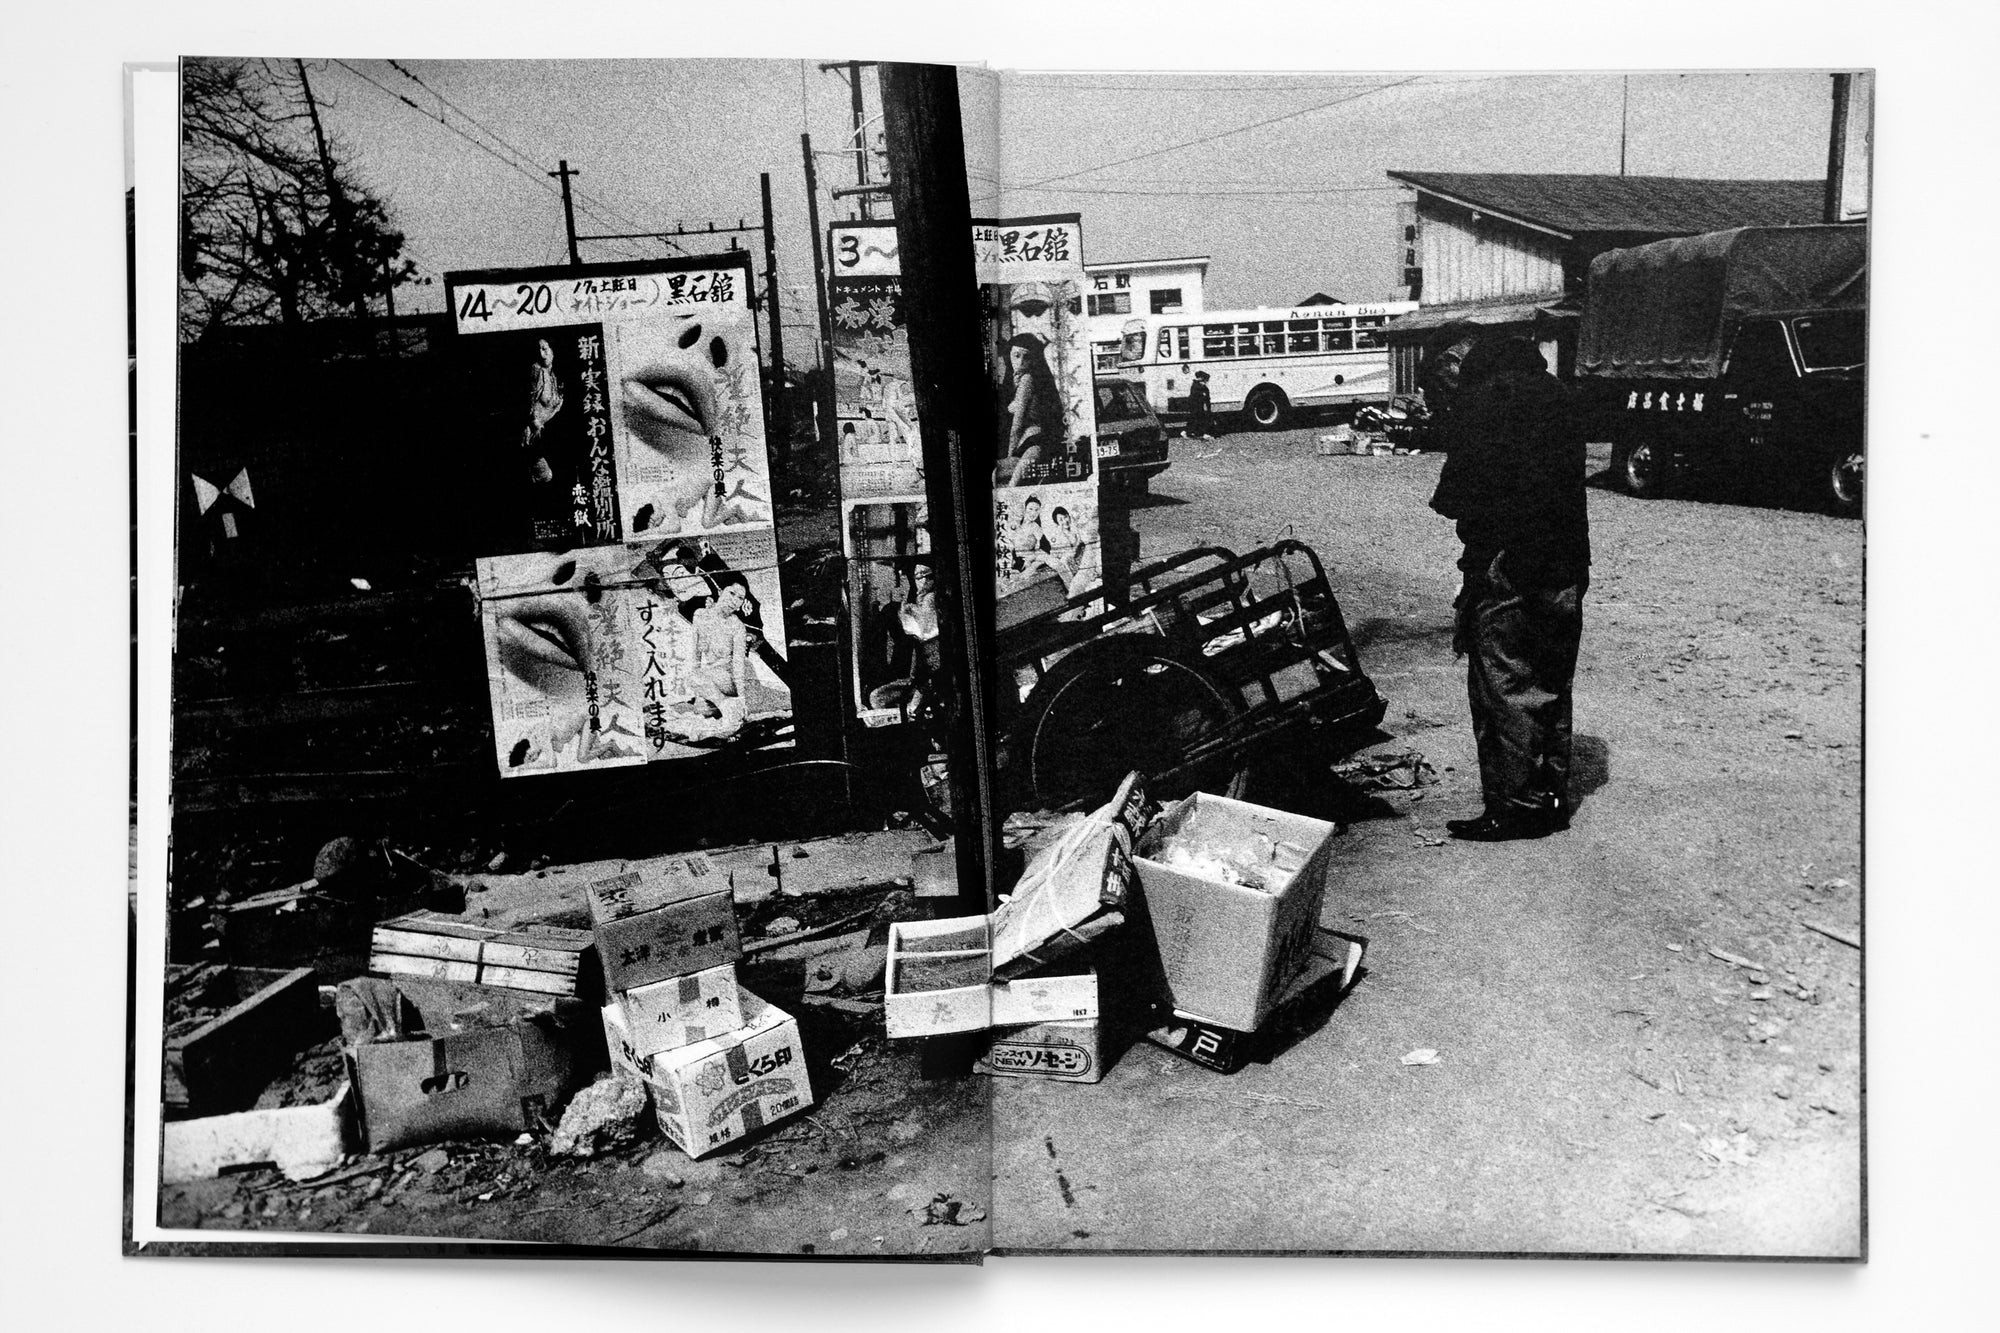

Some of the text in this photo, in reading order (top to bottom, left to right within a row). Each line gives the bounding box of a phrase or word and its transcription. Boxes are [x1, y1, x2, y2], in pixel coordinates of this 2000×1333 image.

[1290, 306, 1386, 319] Konan Bus
[636, 599, 669, 753] すぐ入れます
[994, 1048, 1025, 1058] ニッスイ
[1025, 1049, 1081, 1070] ソーセージ
[994, 1058, 1027, 1067] NEW
